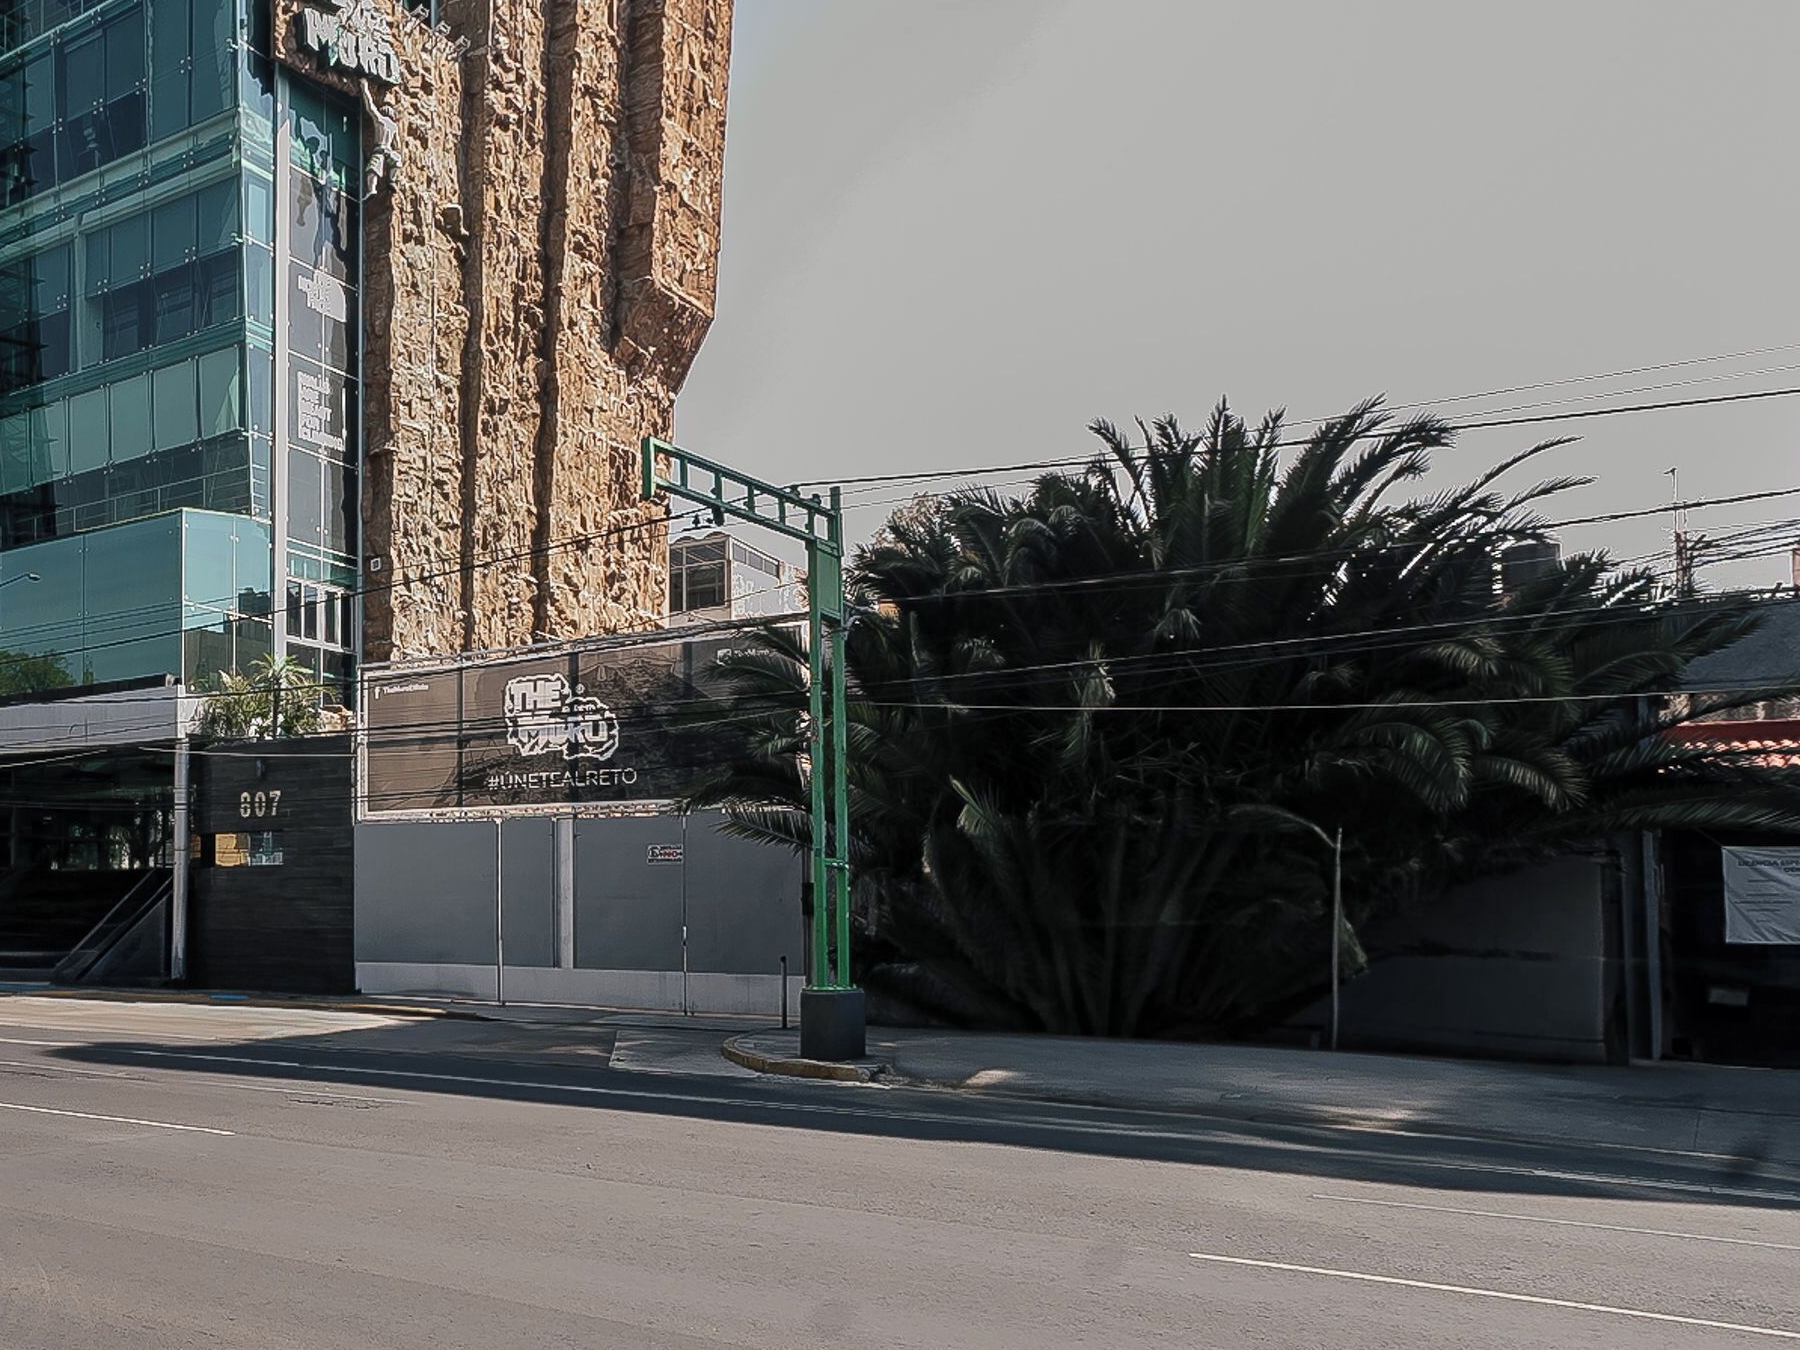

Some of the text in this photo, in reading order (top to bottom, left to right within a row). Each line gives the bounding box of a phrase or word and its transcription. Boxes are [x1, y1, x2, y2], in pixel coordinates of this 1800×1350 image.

[303, 8, 401, 84] MURO
[510, 680, 562, 710] THE
[517, 714, 608, 746] MURO
[488, 767, 638, 791] #ÚNETEALRETO
